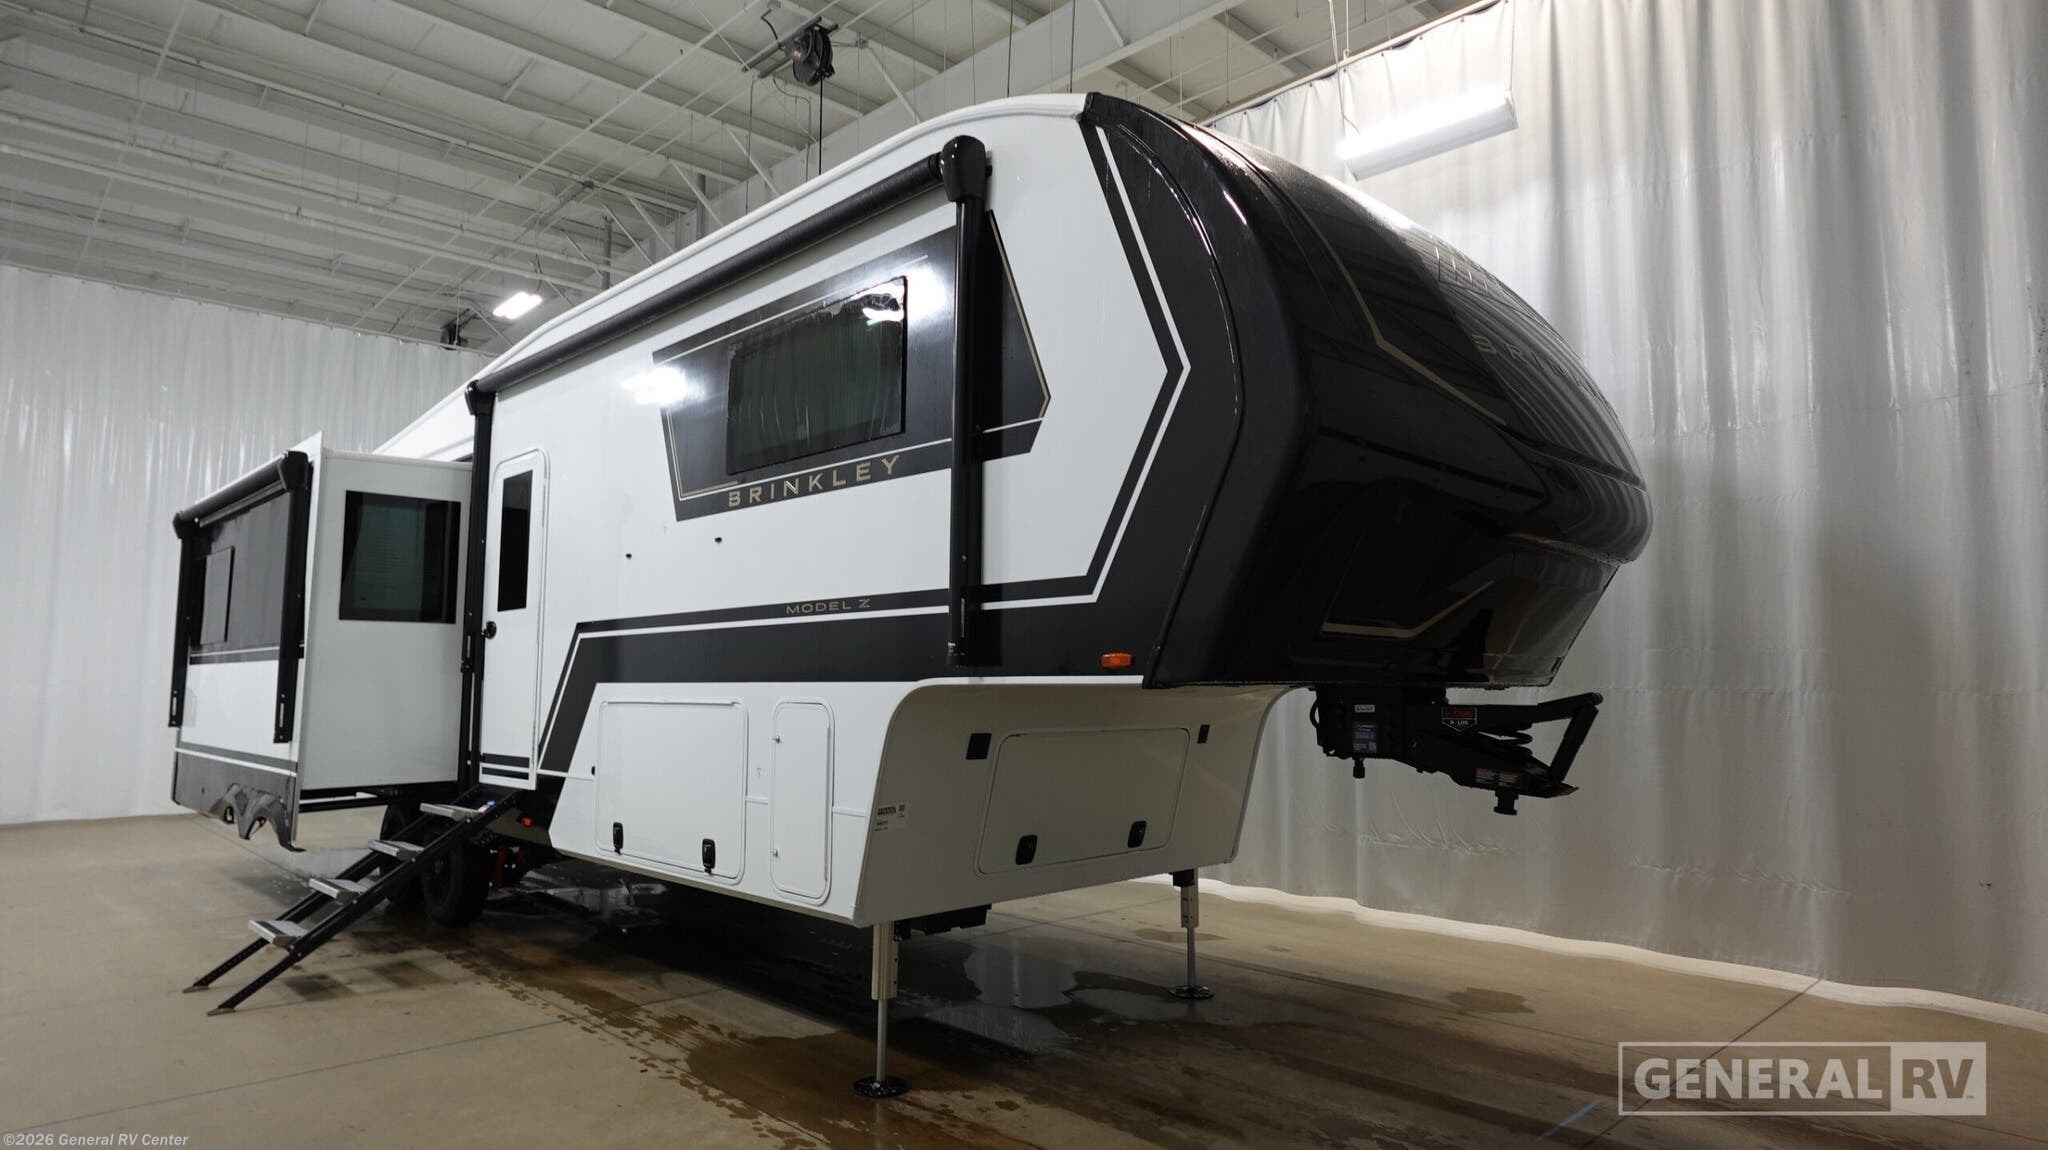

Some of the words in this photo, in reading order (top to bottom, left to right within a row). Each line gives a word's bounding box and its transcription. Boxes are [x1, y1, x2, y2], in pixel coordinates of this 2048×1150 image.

[728, 455, 900, 508] BRINKLEY
[785, 601, 852, 615] MODEL
[858, 598, 871, 609] Z
